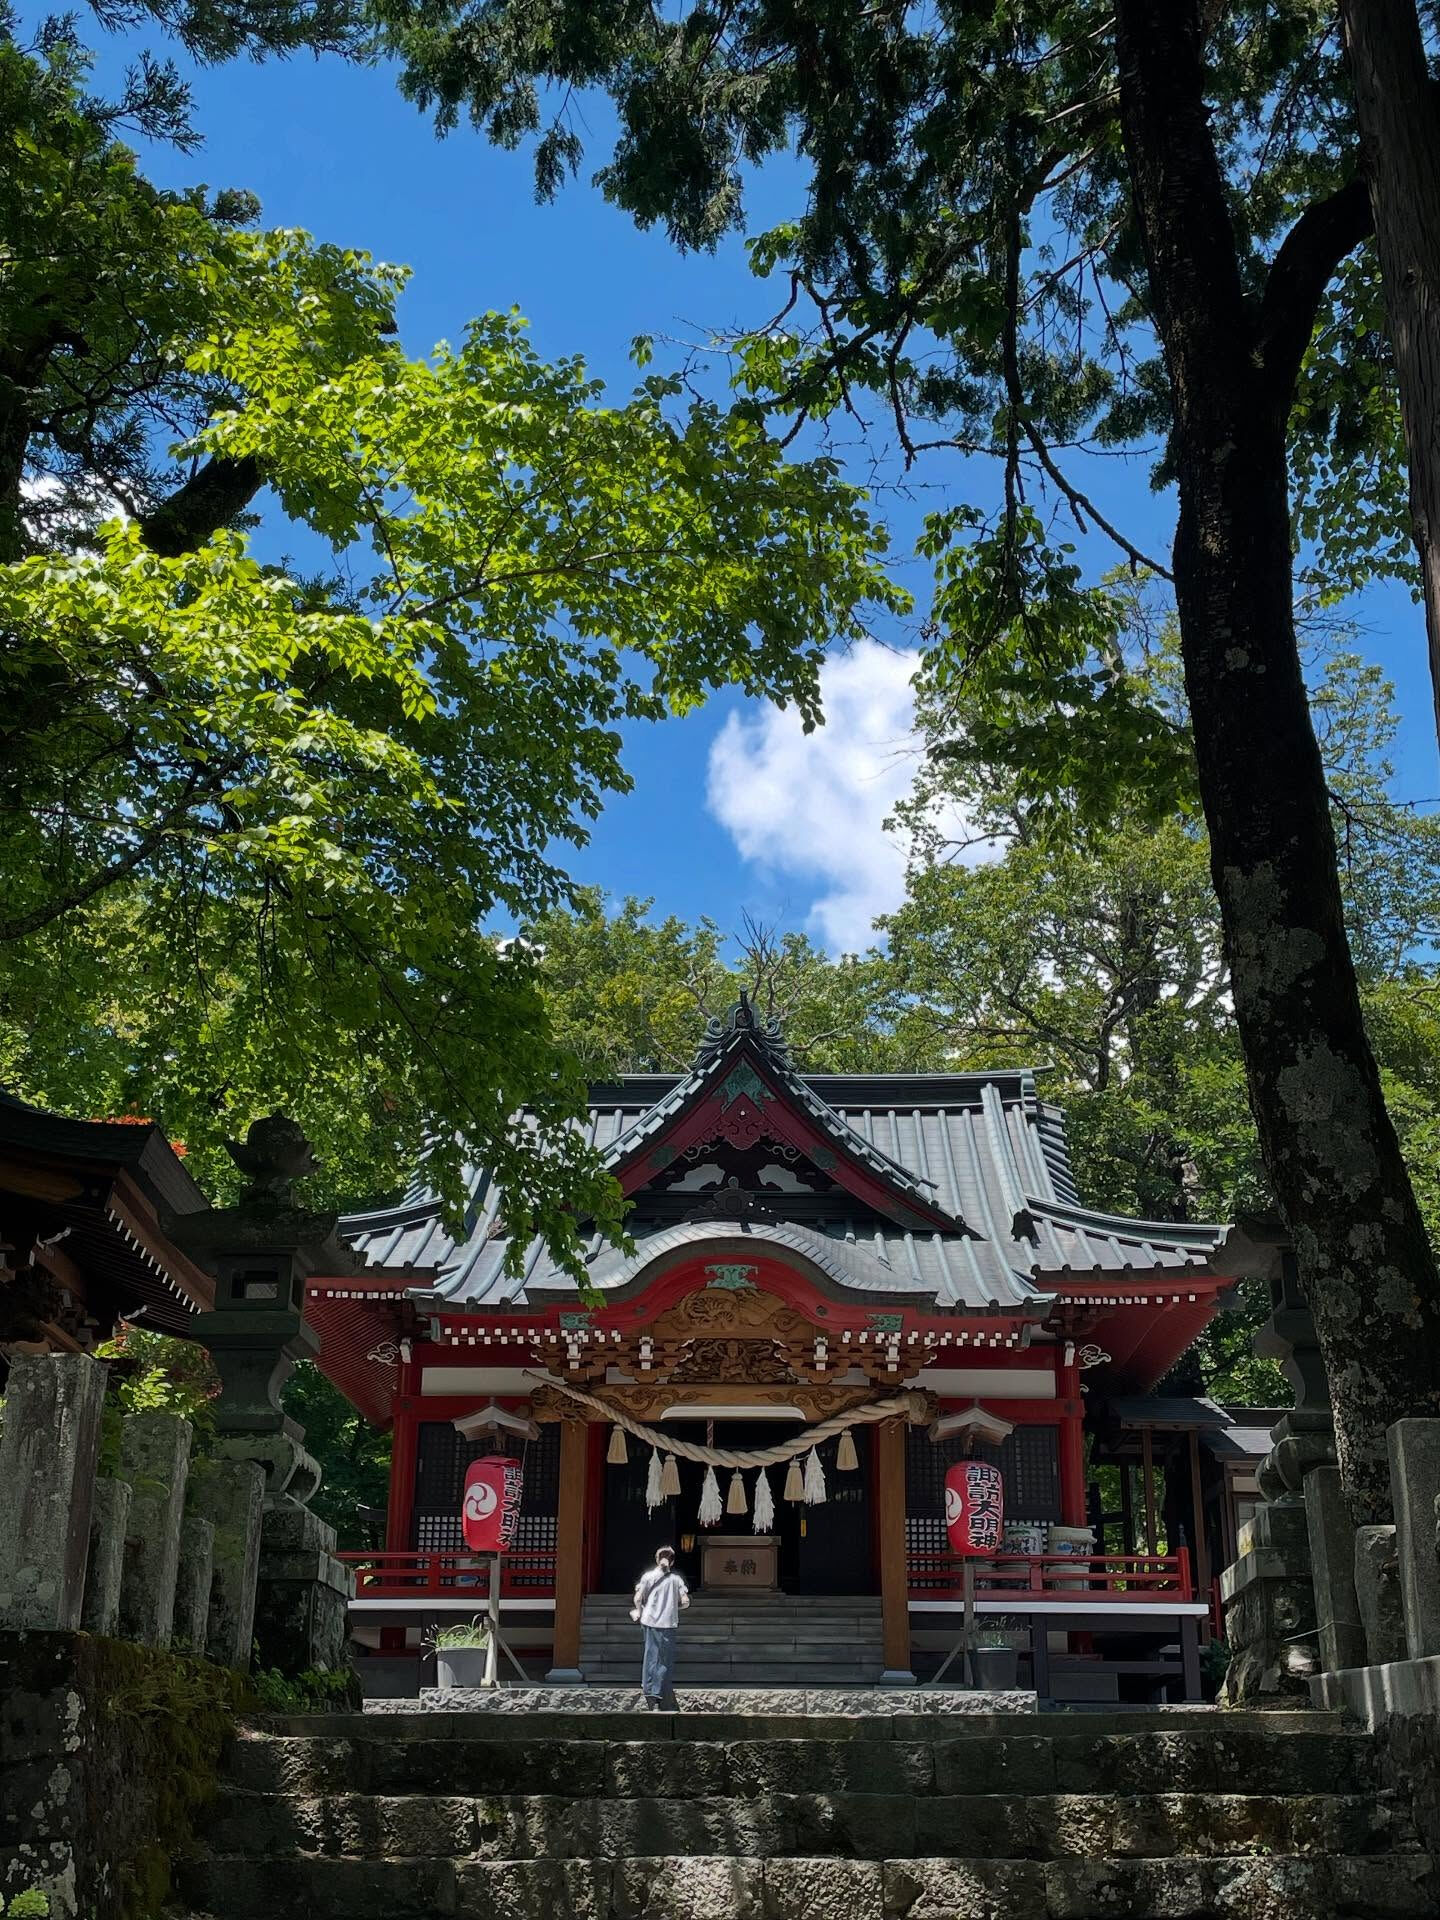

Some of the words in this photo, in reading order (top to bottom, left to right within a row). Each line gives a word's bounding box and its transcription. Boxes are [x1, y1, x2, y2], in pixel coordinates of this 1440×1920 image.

[967, 1465, 1001, 1549] 諏訪大明神
